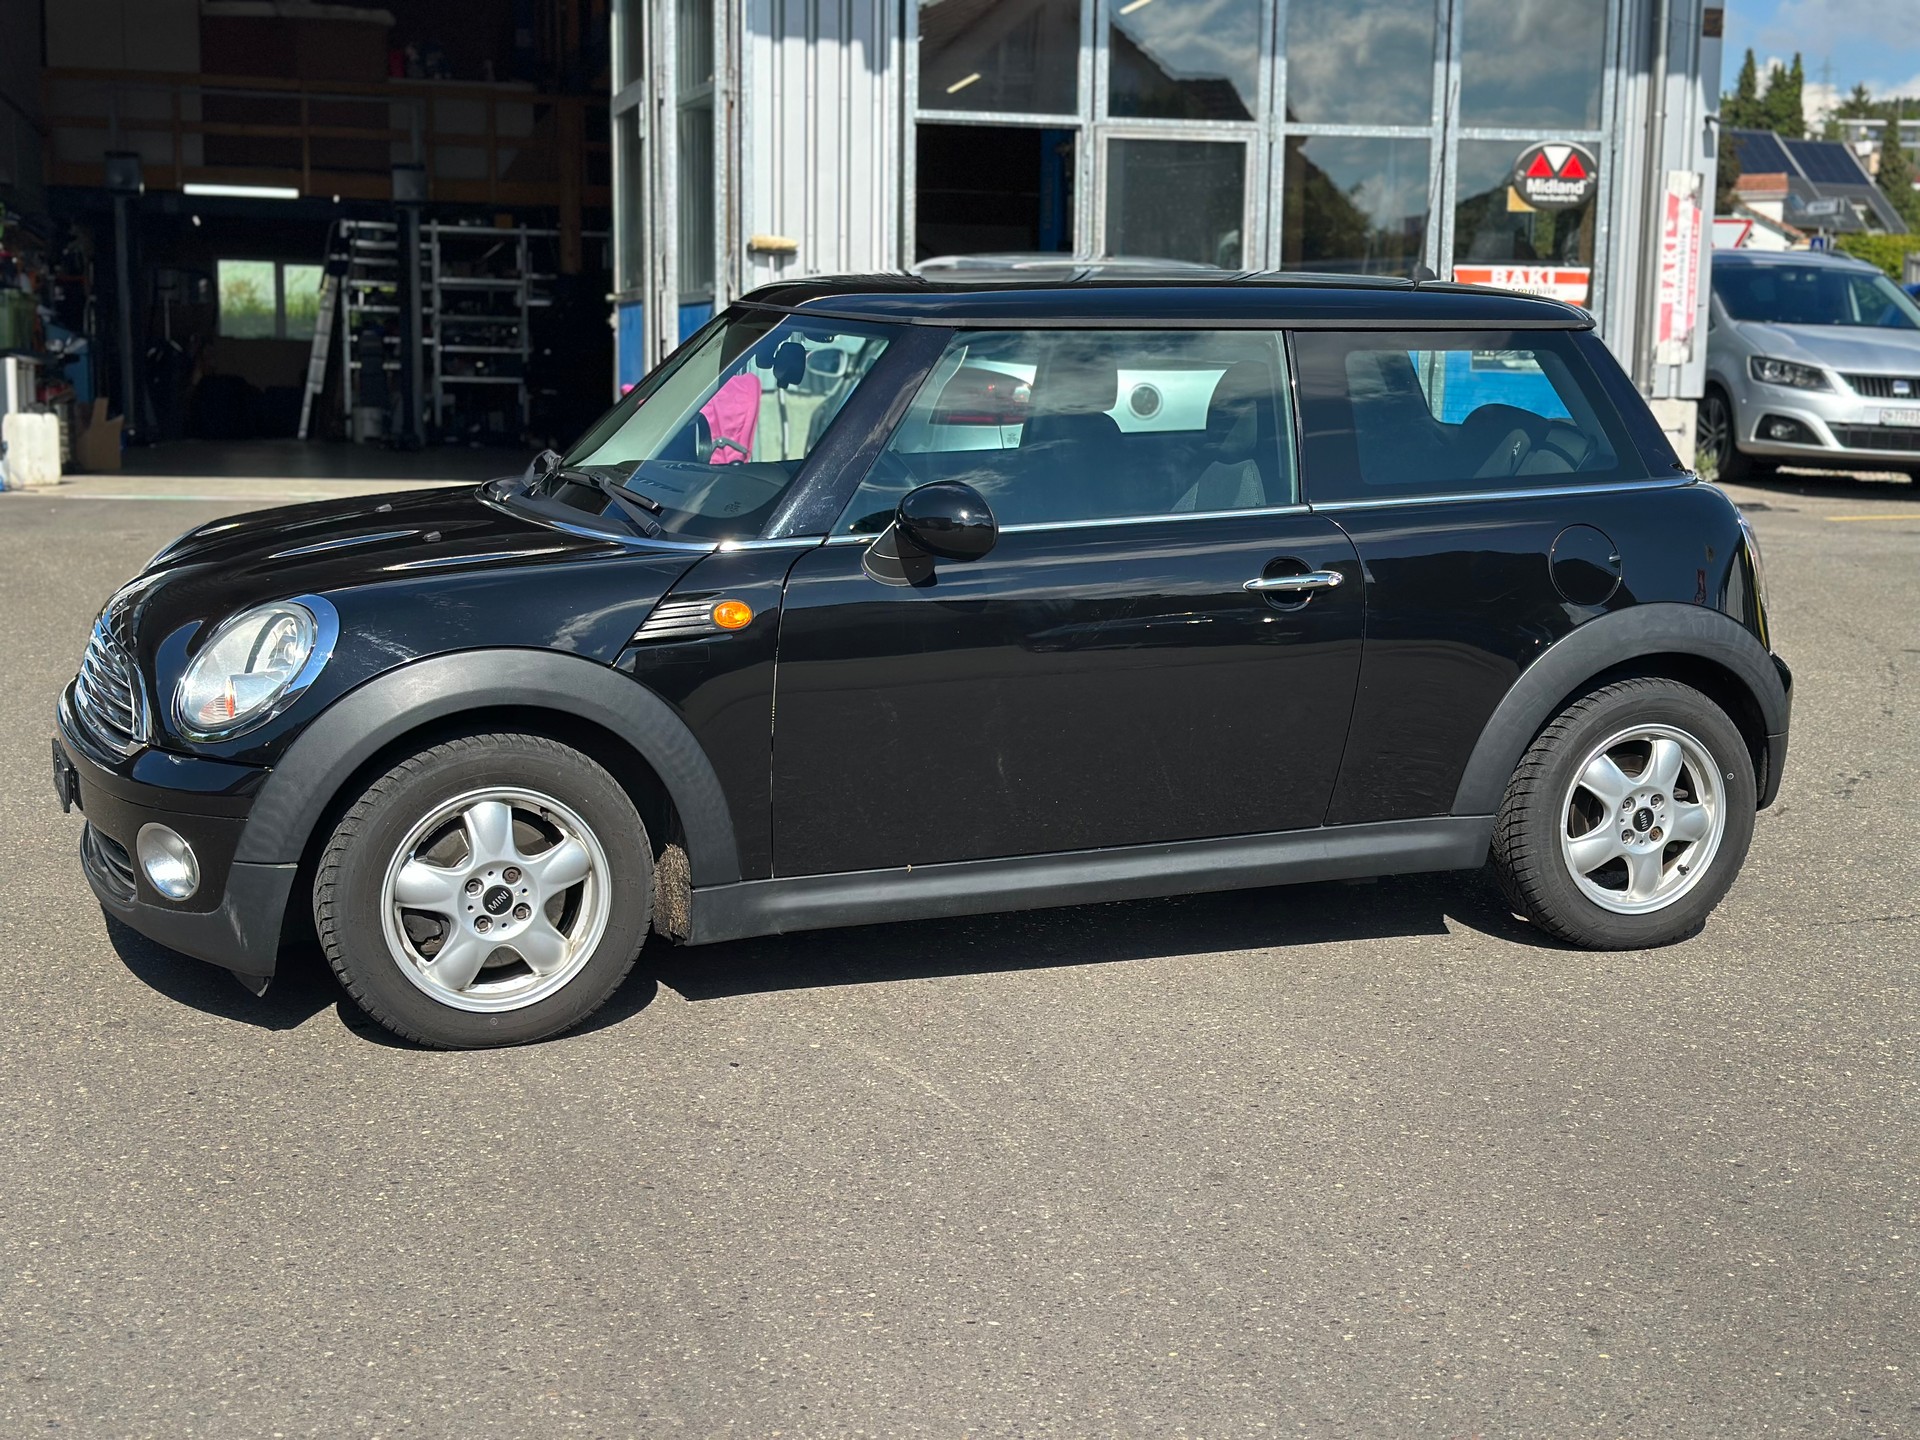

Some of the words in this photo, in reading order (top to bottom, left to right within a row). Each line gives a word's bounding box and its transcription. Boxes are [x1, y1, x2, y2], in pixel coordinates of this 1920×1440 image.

[1526, 178, 1585, 195] Midland
[1491, 267, 1556, 285] BAKI
[1661, 237, 1678, 303] BAKI
[1639, 810, 1648, 830] MINI
[487, 890, 510, 911] MINI
